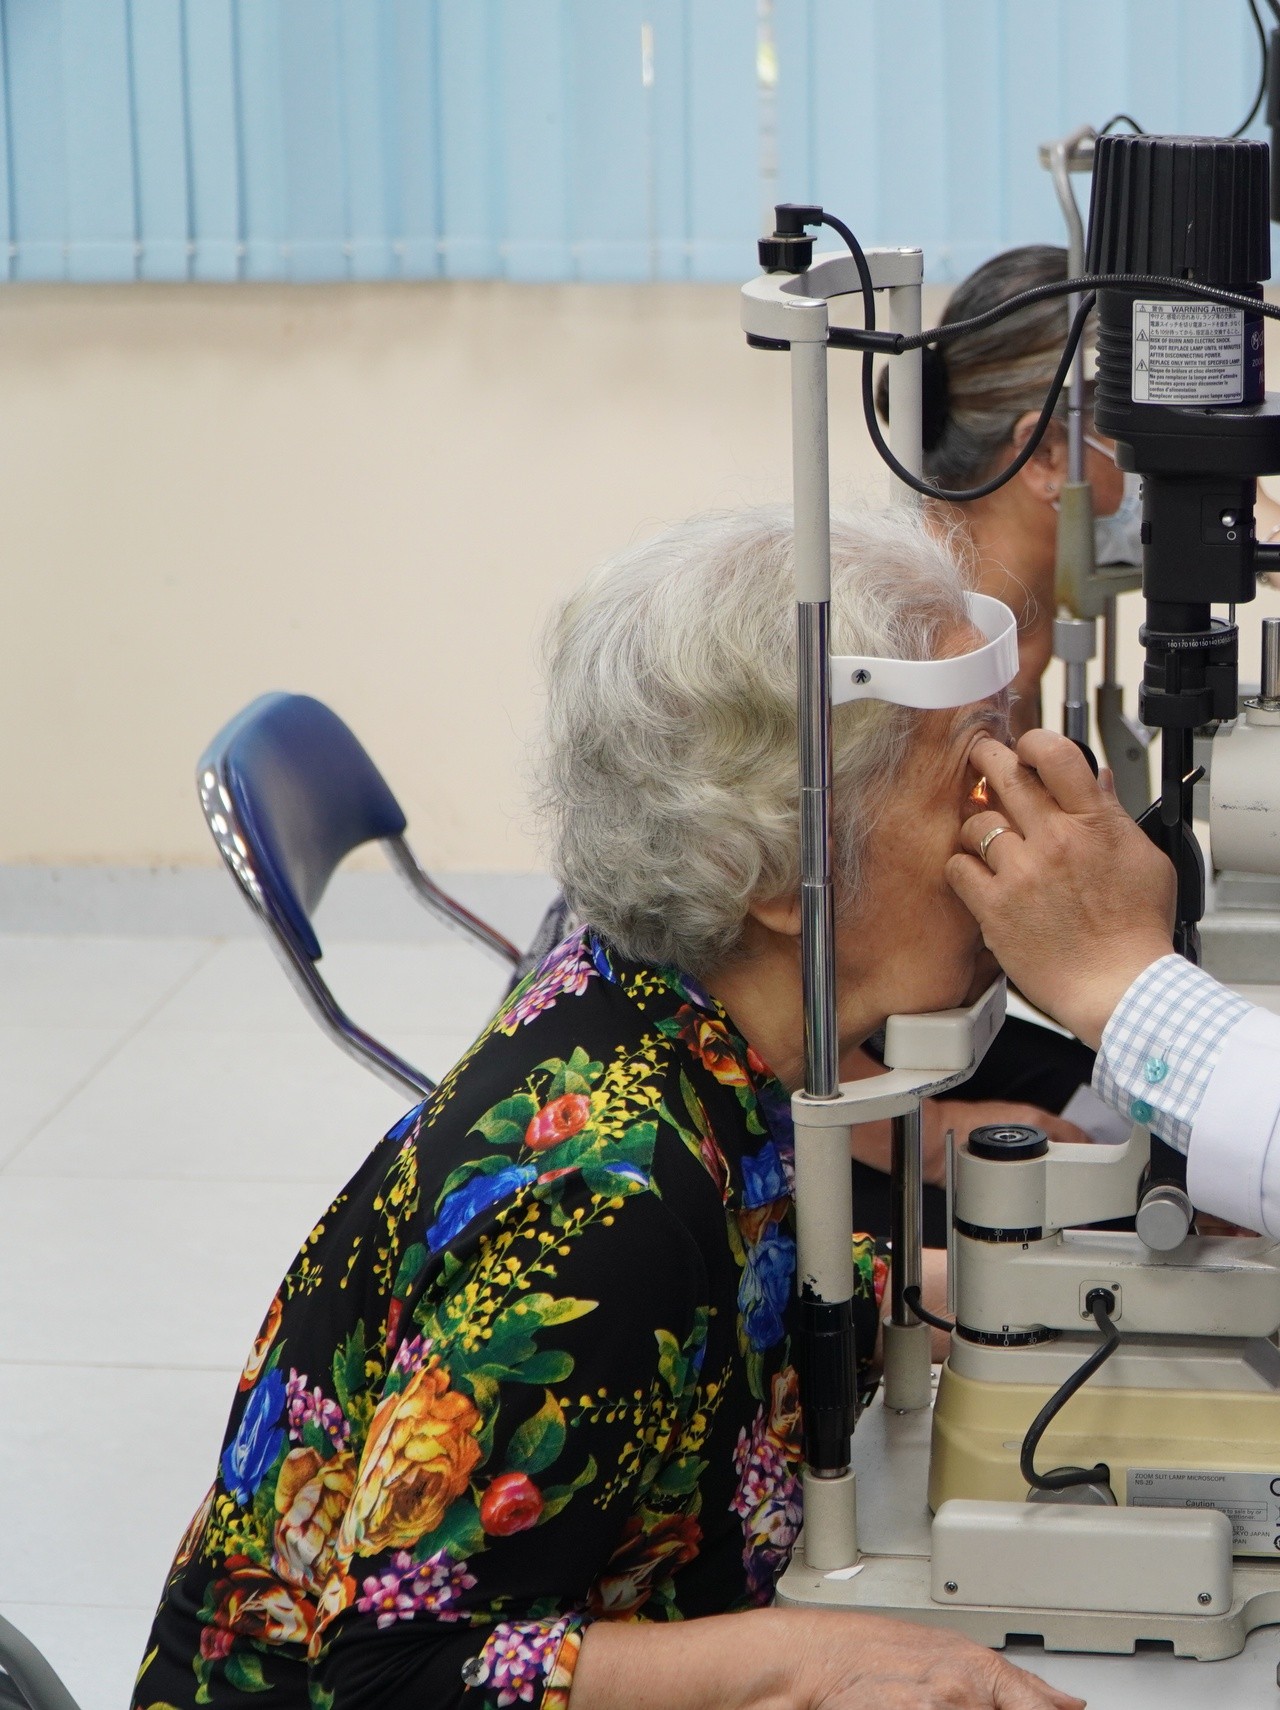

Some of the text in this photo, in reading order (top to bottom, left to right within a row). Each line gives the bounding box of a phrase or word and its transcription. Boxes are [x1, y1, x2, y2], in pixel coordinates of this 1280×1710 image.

[994, 1228, 1004, 1237] 30
[1023, 1227, 1029, 1236] 0
[1003, 1337, 1010, 1347] 0
[1028, 1336, 1037, 1344] 30
